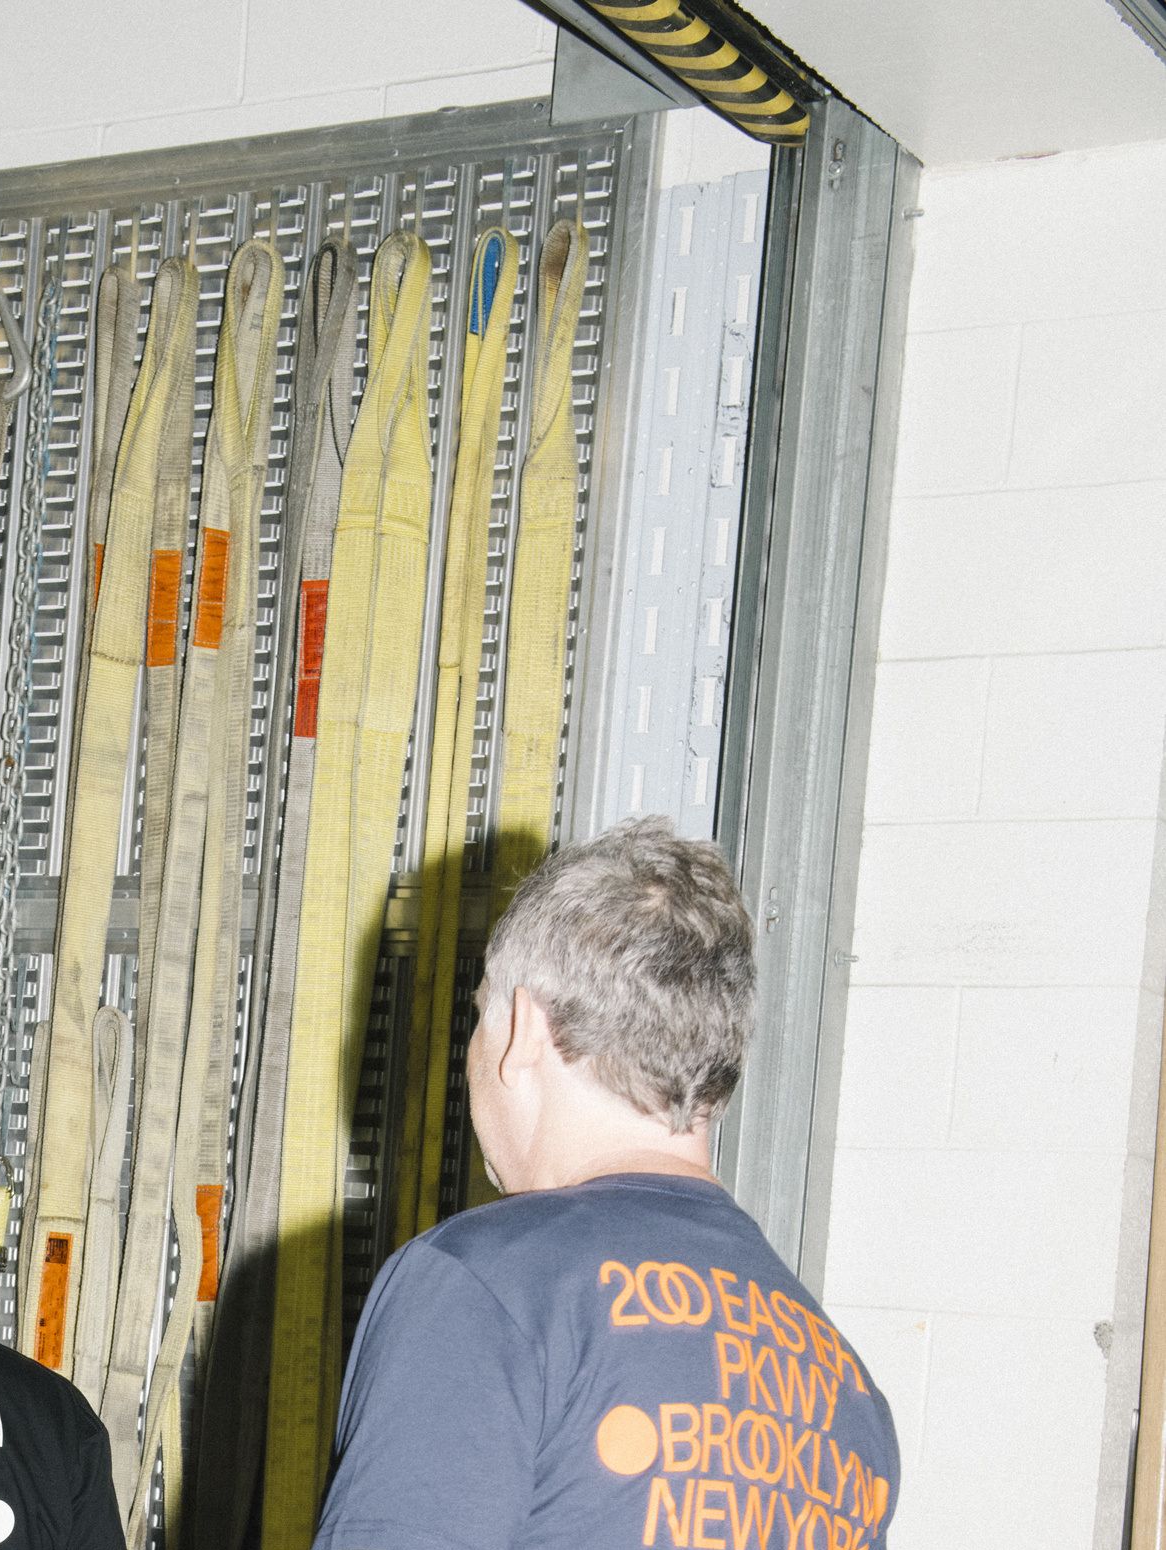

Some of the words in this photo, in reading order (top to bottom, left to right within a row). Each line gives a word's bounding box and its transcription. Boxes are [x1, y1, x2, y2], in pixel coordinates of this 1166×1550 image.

[600, 1261, 712, 1326] 200
[715, 1332, 840, 1432] PKWY
[659, 1403, 876, 1529] BROOKLYN
